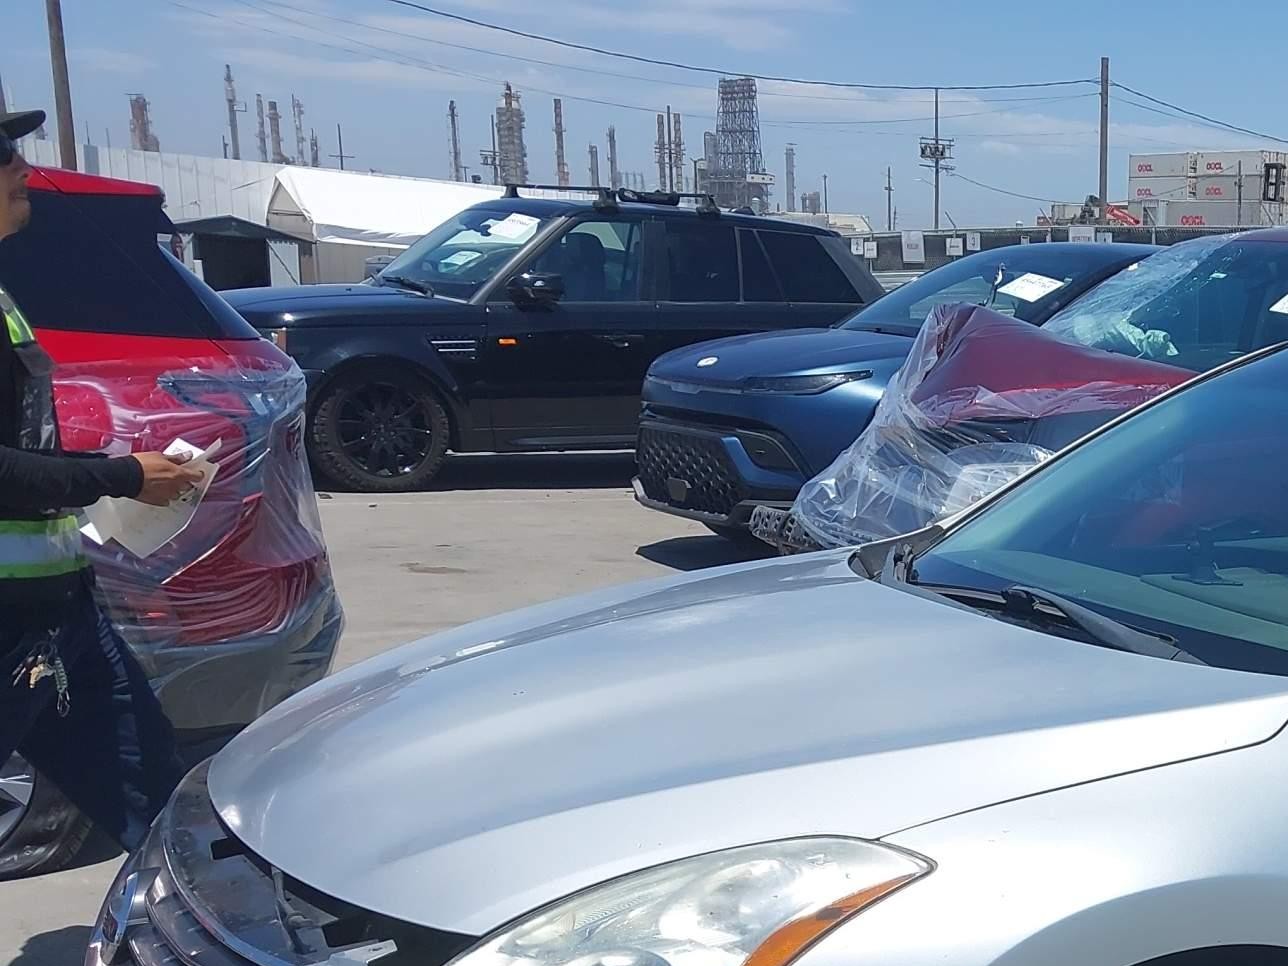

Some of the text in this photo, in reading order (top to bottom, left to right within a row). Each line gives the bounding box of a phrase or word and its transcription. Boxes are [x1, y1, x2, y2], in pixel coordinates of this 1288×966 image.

[1137, 163, 1153, 172] OOCL
[1206, 161, 1223, 171] OOCL
[1137, 188, 1153, 197] OOCL
[1181, 215, 1206, 226] OOCL
